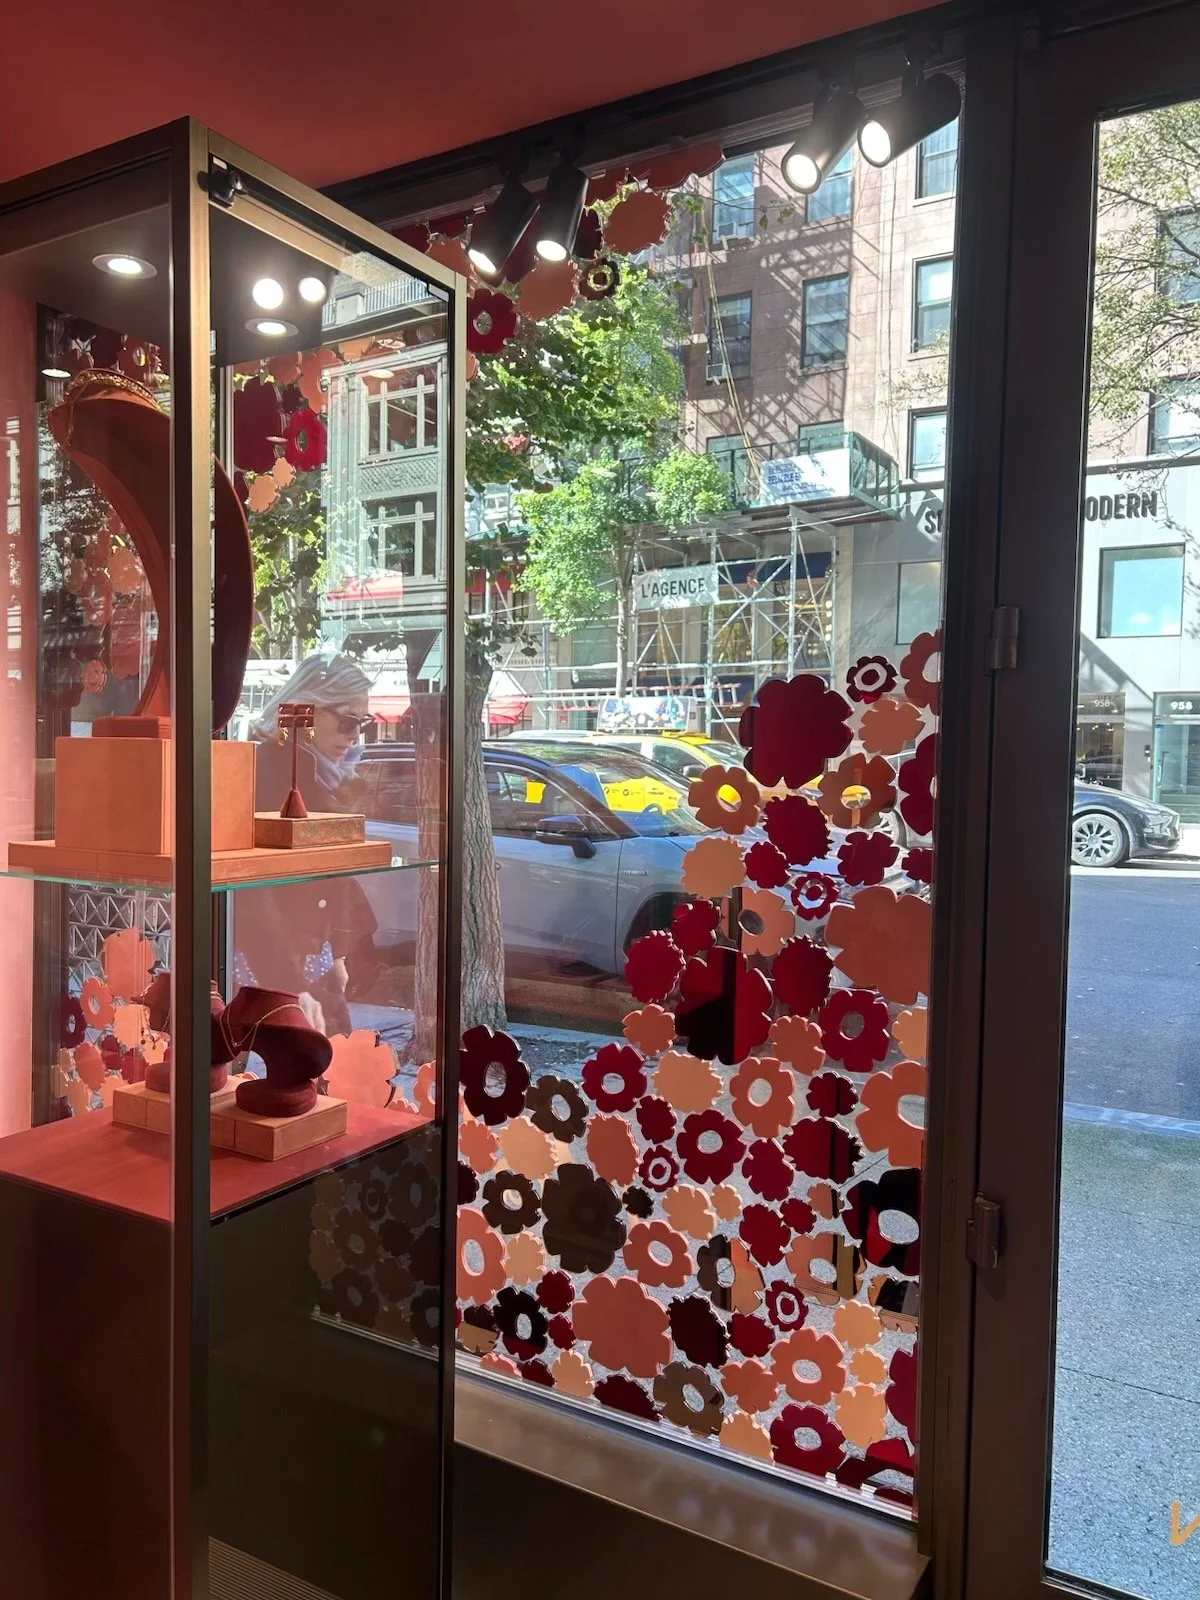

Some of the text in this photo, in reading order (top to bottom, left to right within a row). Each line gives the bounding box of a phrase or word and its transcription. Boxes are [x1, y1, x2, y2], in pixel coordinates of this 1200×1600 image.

[641, 578, 705, 598] L'AGENCE
[1094, 698, 1111, 708] 958
[1170, 701, 1193, 711] 958
